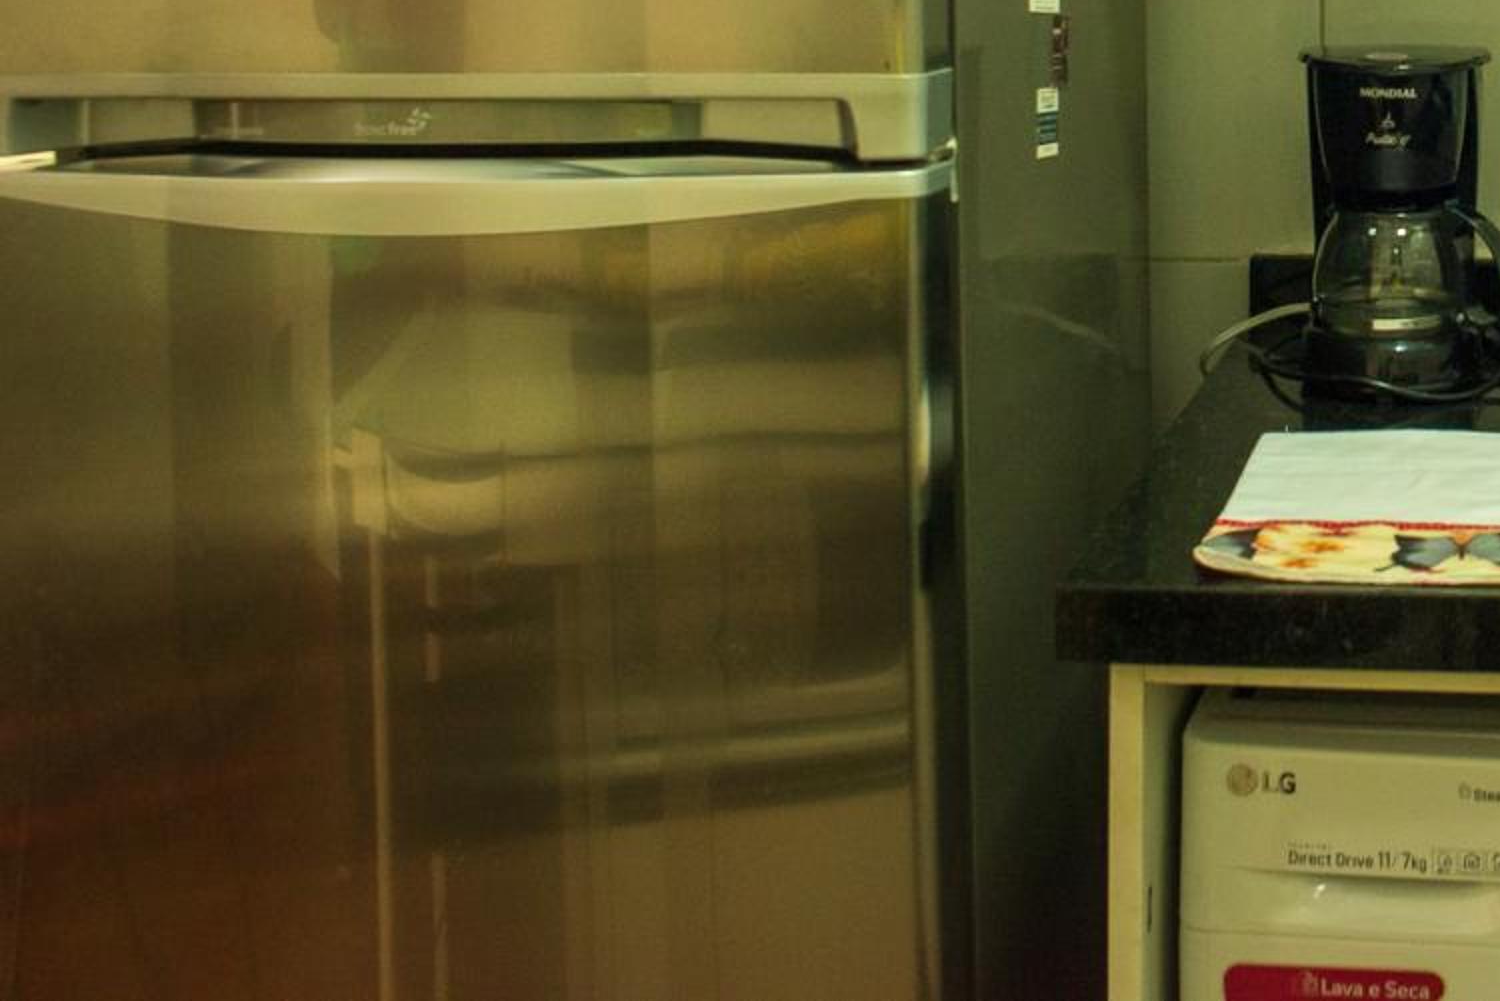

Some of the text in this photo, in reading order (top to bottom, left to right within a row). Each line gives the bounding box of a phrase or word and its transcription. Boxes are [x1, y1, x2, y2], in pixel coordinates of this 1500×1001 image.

[1359, 87, 1417, 99] MONDIAL
[1262, 771, 1296, 795] LG
[1288, 850, 1331, 867] Direct
[1336, 851, 1374, 868] Drive
[1321, 978, 1430, 1000] Lava e Seca
